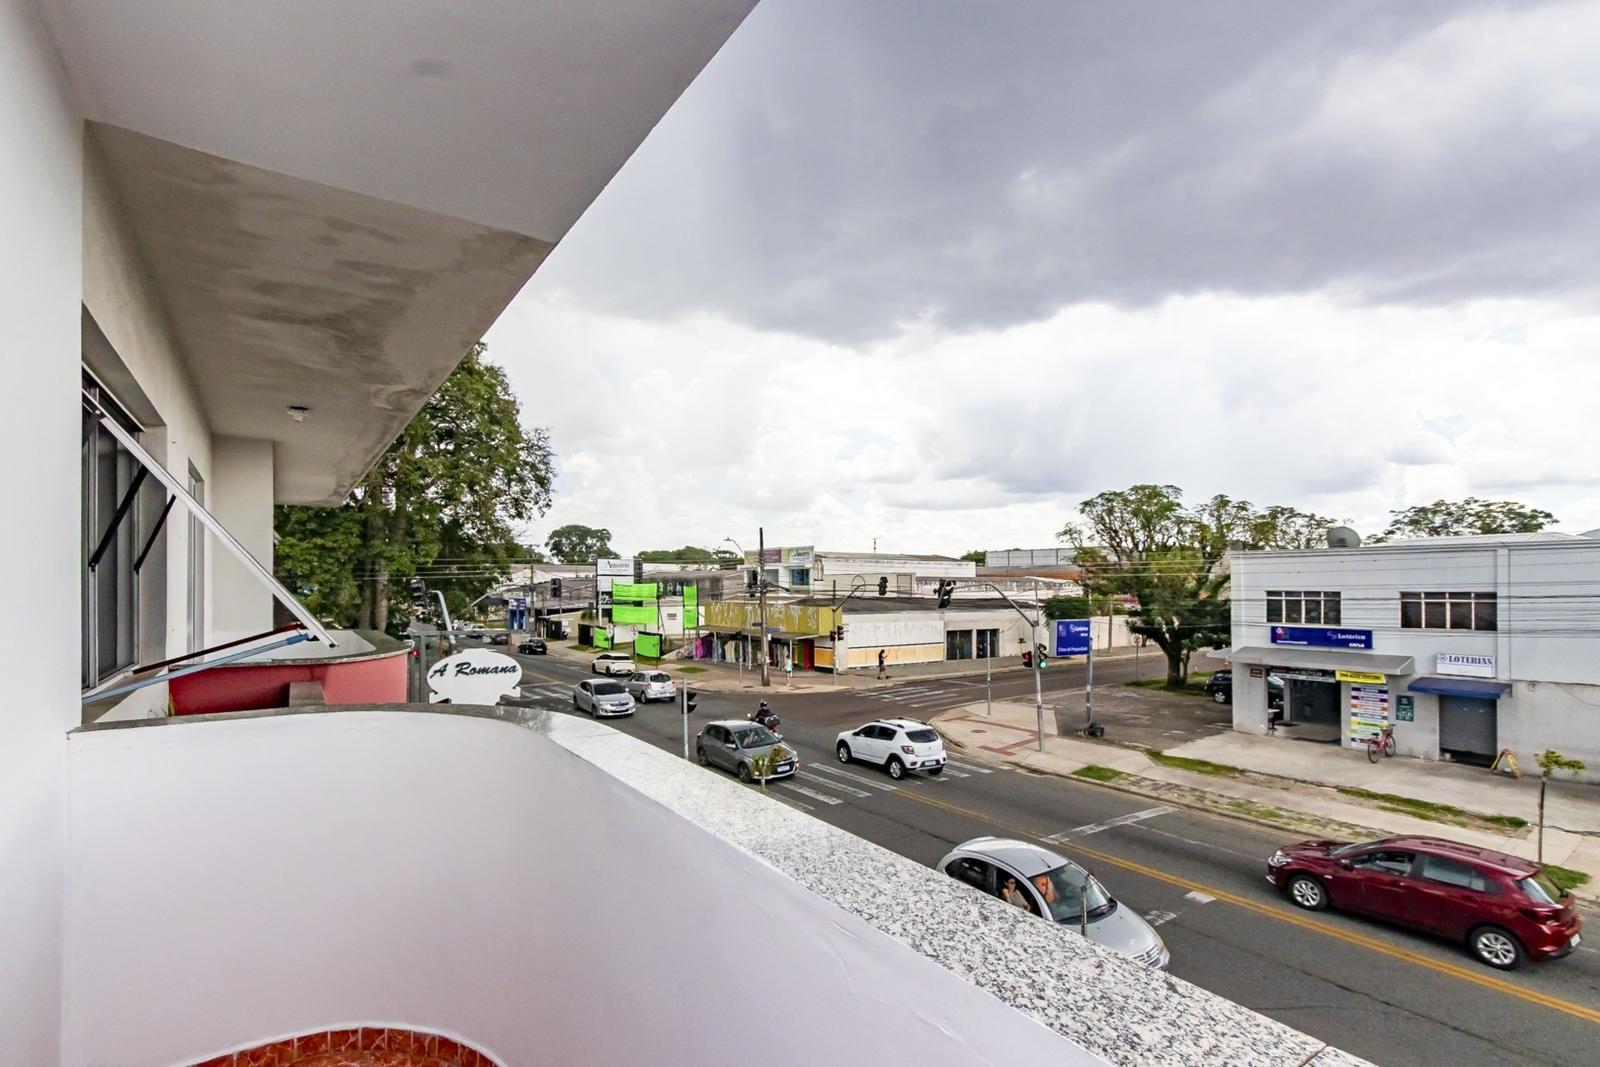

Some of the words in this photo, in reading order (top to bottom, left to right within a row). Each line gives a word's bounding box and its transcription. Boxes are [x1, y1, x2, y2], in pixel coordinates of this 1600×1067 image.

[1449, 655, 1493, 665] LOTERIAS
[430, 663, 449, 679] A
[454, 661, 519, 677] Romana
